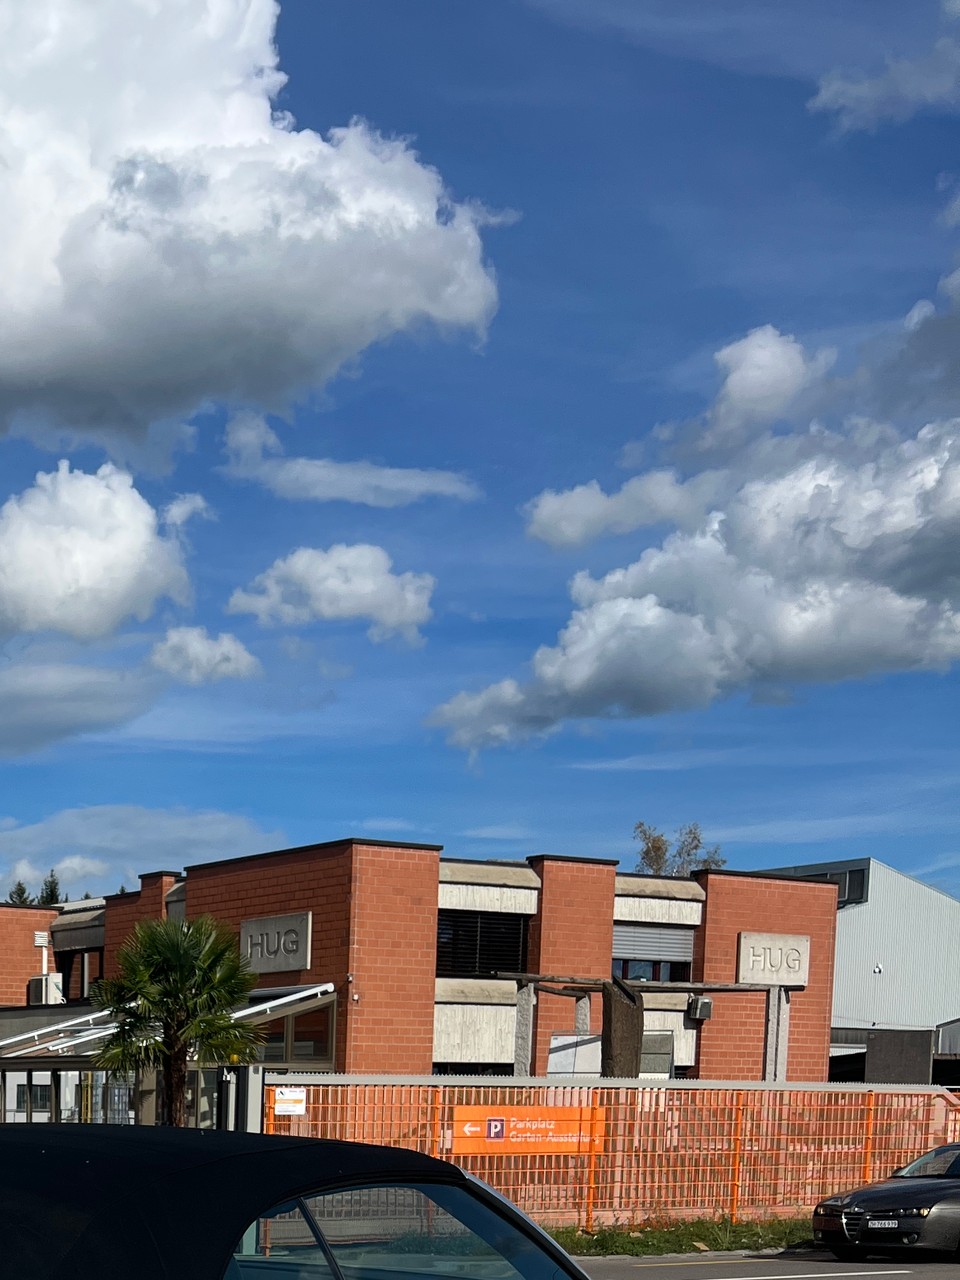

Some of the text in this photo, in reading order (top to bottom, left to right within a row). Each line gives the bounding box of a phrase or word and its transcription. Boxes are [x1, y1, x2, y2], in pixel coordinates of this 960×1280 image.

[247, 928, 299, 959] HUG
[750, 946, 801, 973] HUG
[490, 1121, 501, 1138] P
[510, 1117, 555, 1130] Parkplatz
